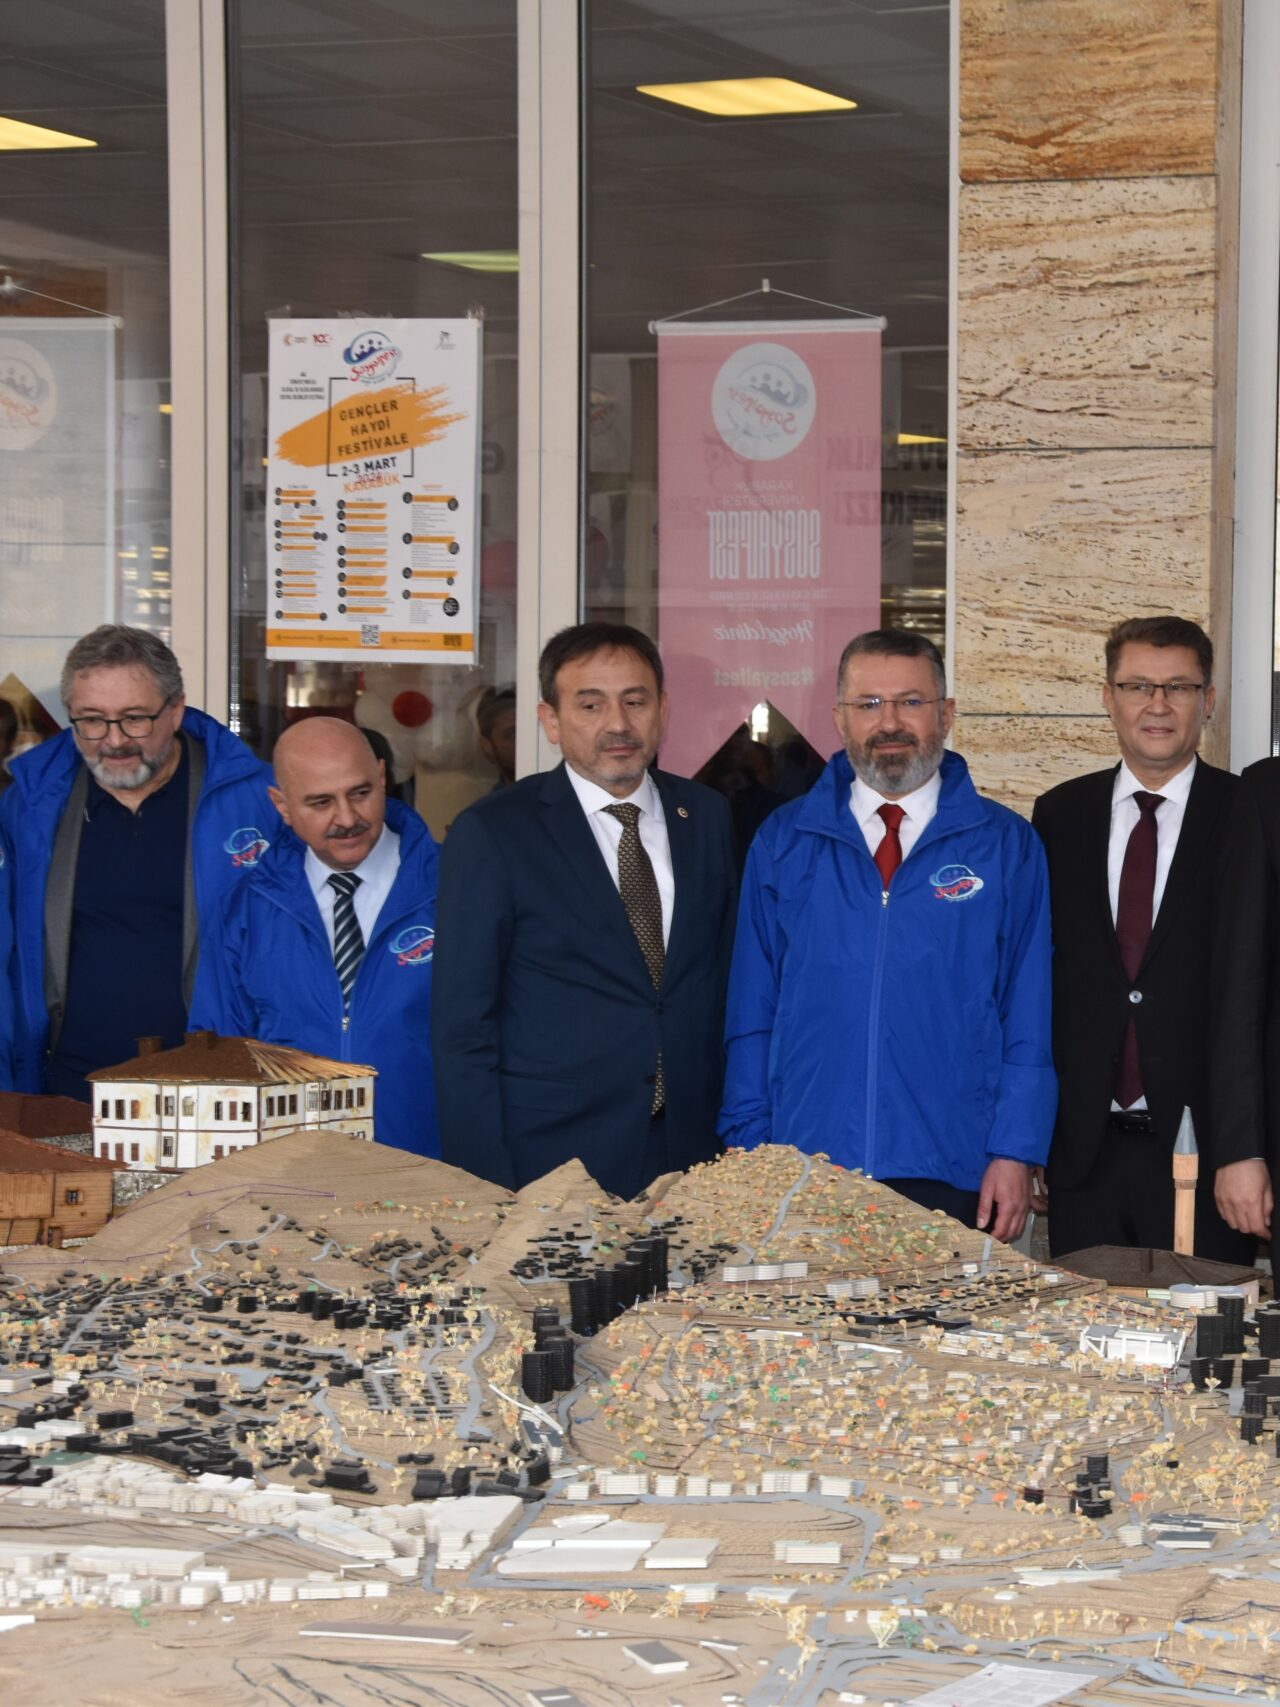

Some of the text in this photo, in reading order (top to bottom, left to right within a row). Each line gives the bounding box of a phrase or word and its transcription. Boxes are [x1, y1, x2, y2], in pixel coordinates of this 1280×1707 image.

[339, 399, 399, 422] GENÇLER
[350, 416, 391, 437] HAYDİ
[337, 432, 409, 457] FESTİVALE
[341, 456, 398, 478] 2-3 MART
